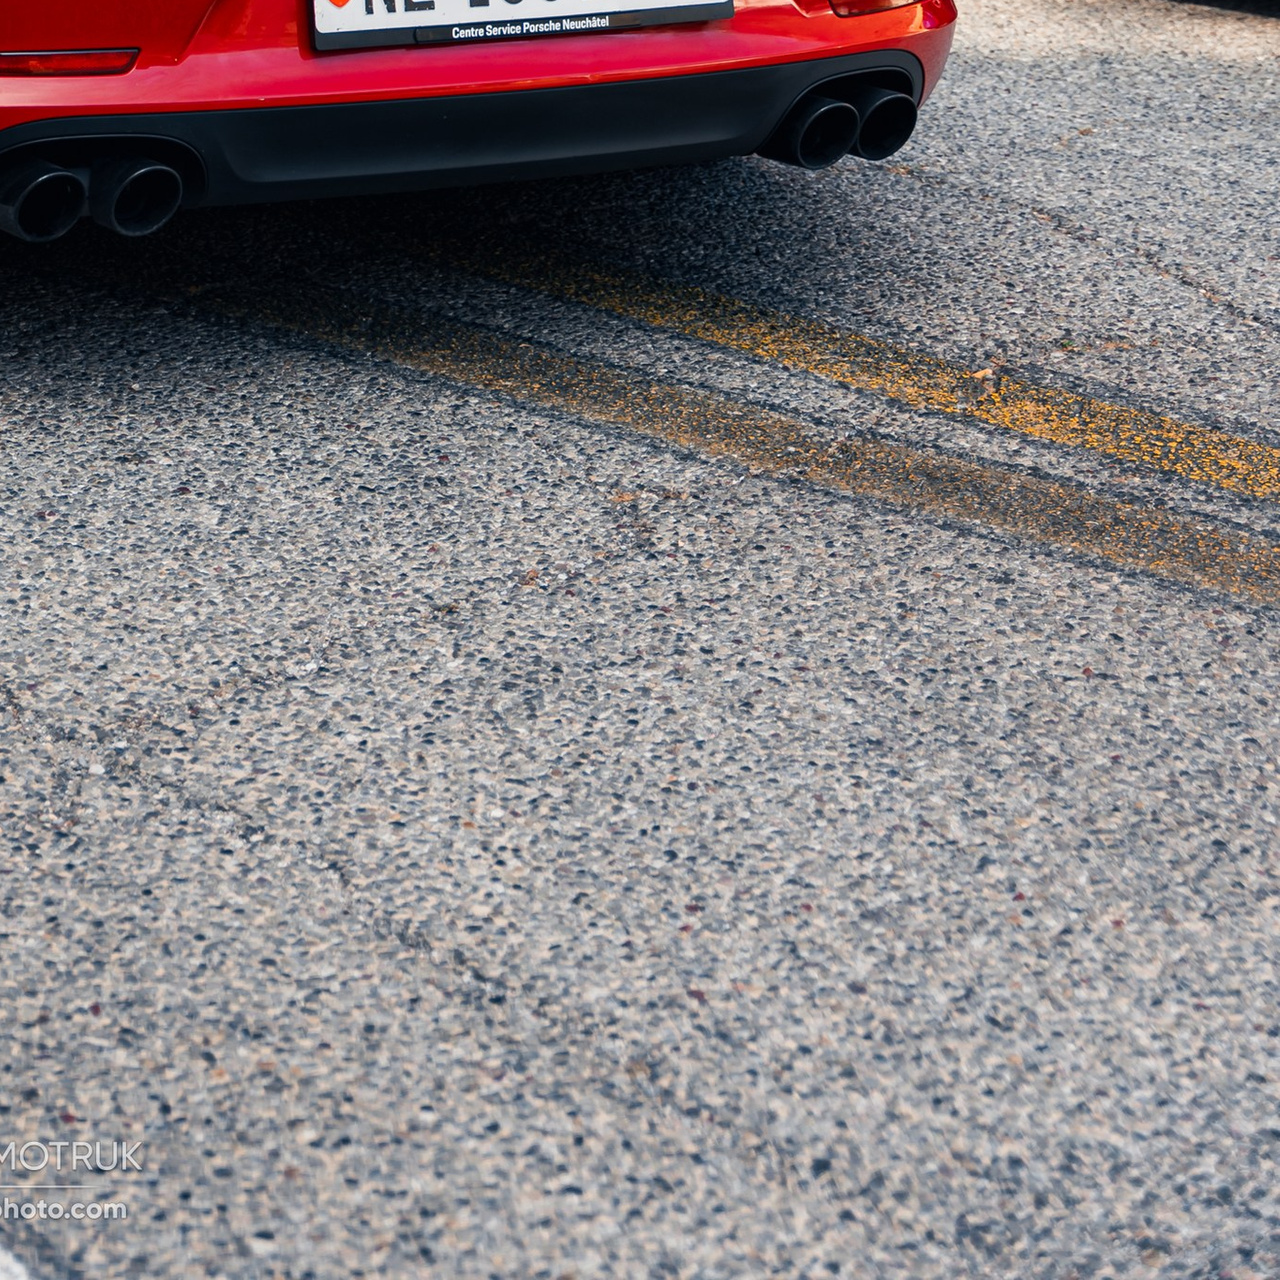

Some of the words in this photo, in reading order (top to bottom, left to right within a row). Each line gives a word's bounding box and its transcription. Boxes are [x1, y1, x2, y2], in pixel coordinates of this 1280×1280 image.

[452, 27, 484, 39] Centre
[485, 23, 521, 36] Service
[523, 20, 561, 33] Porsche
[562, 15, 609, 30] Neuchâtel
